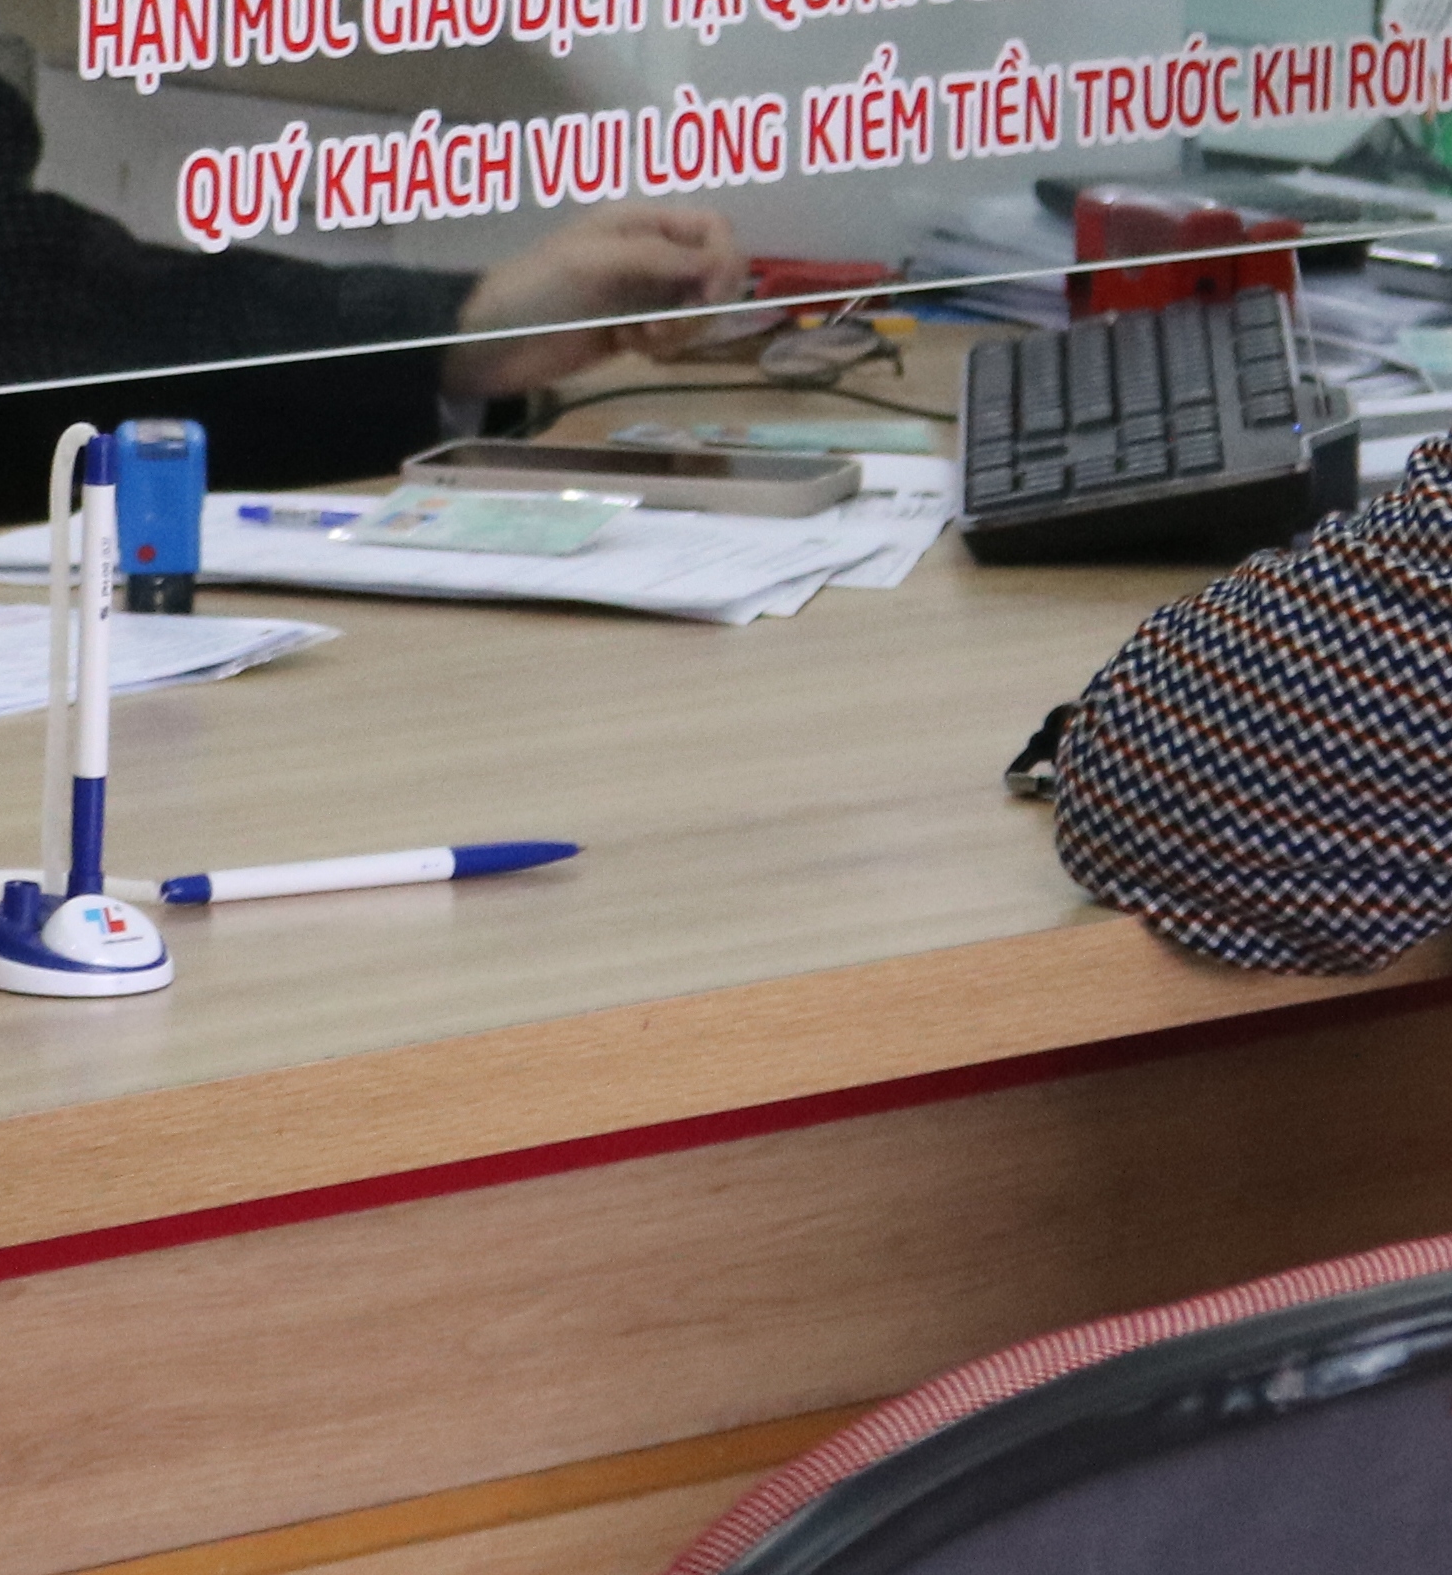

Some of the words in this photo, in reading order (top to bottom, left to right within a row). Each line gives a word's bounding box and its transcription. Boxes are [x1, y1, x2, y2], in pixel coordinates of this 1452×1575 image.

[182, 127, 307, 243] QUÝ
[321, 116, 516, 221] KHÁCH
[531, 115, 626, 199] VUI
[641, 88, 784, 188] LÒNG
[806, 46, 931, 168] KIỂM
[944, 43, 1060, 152] TIỀN
[1073, 39, 1241, 139] TRƯỚC
[1252, 45, 1334, 120] KHI
[1346, 22, 1429, 110] RỜI
